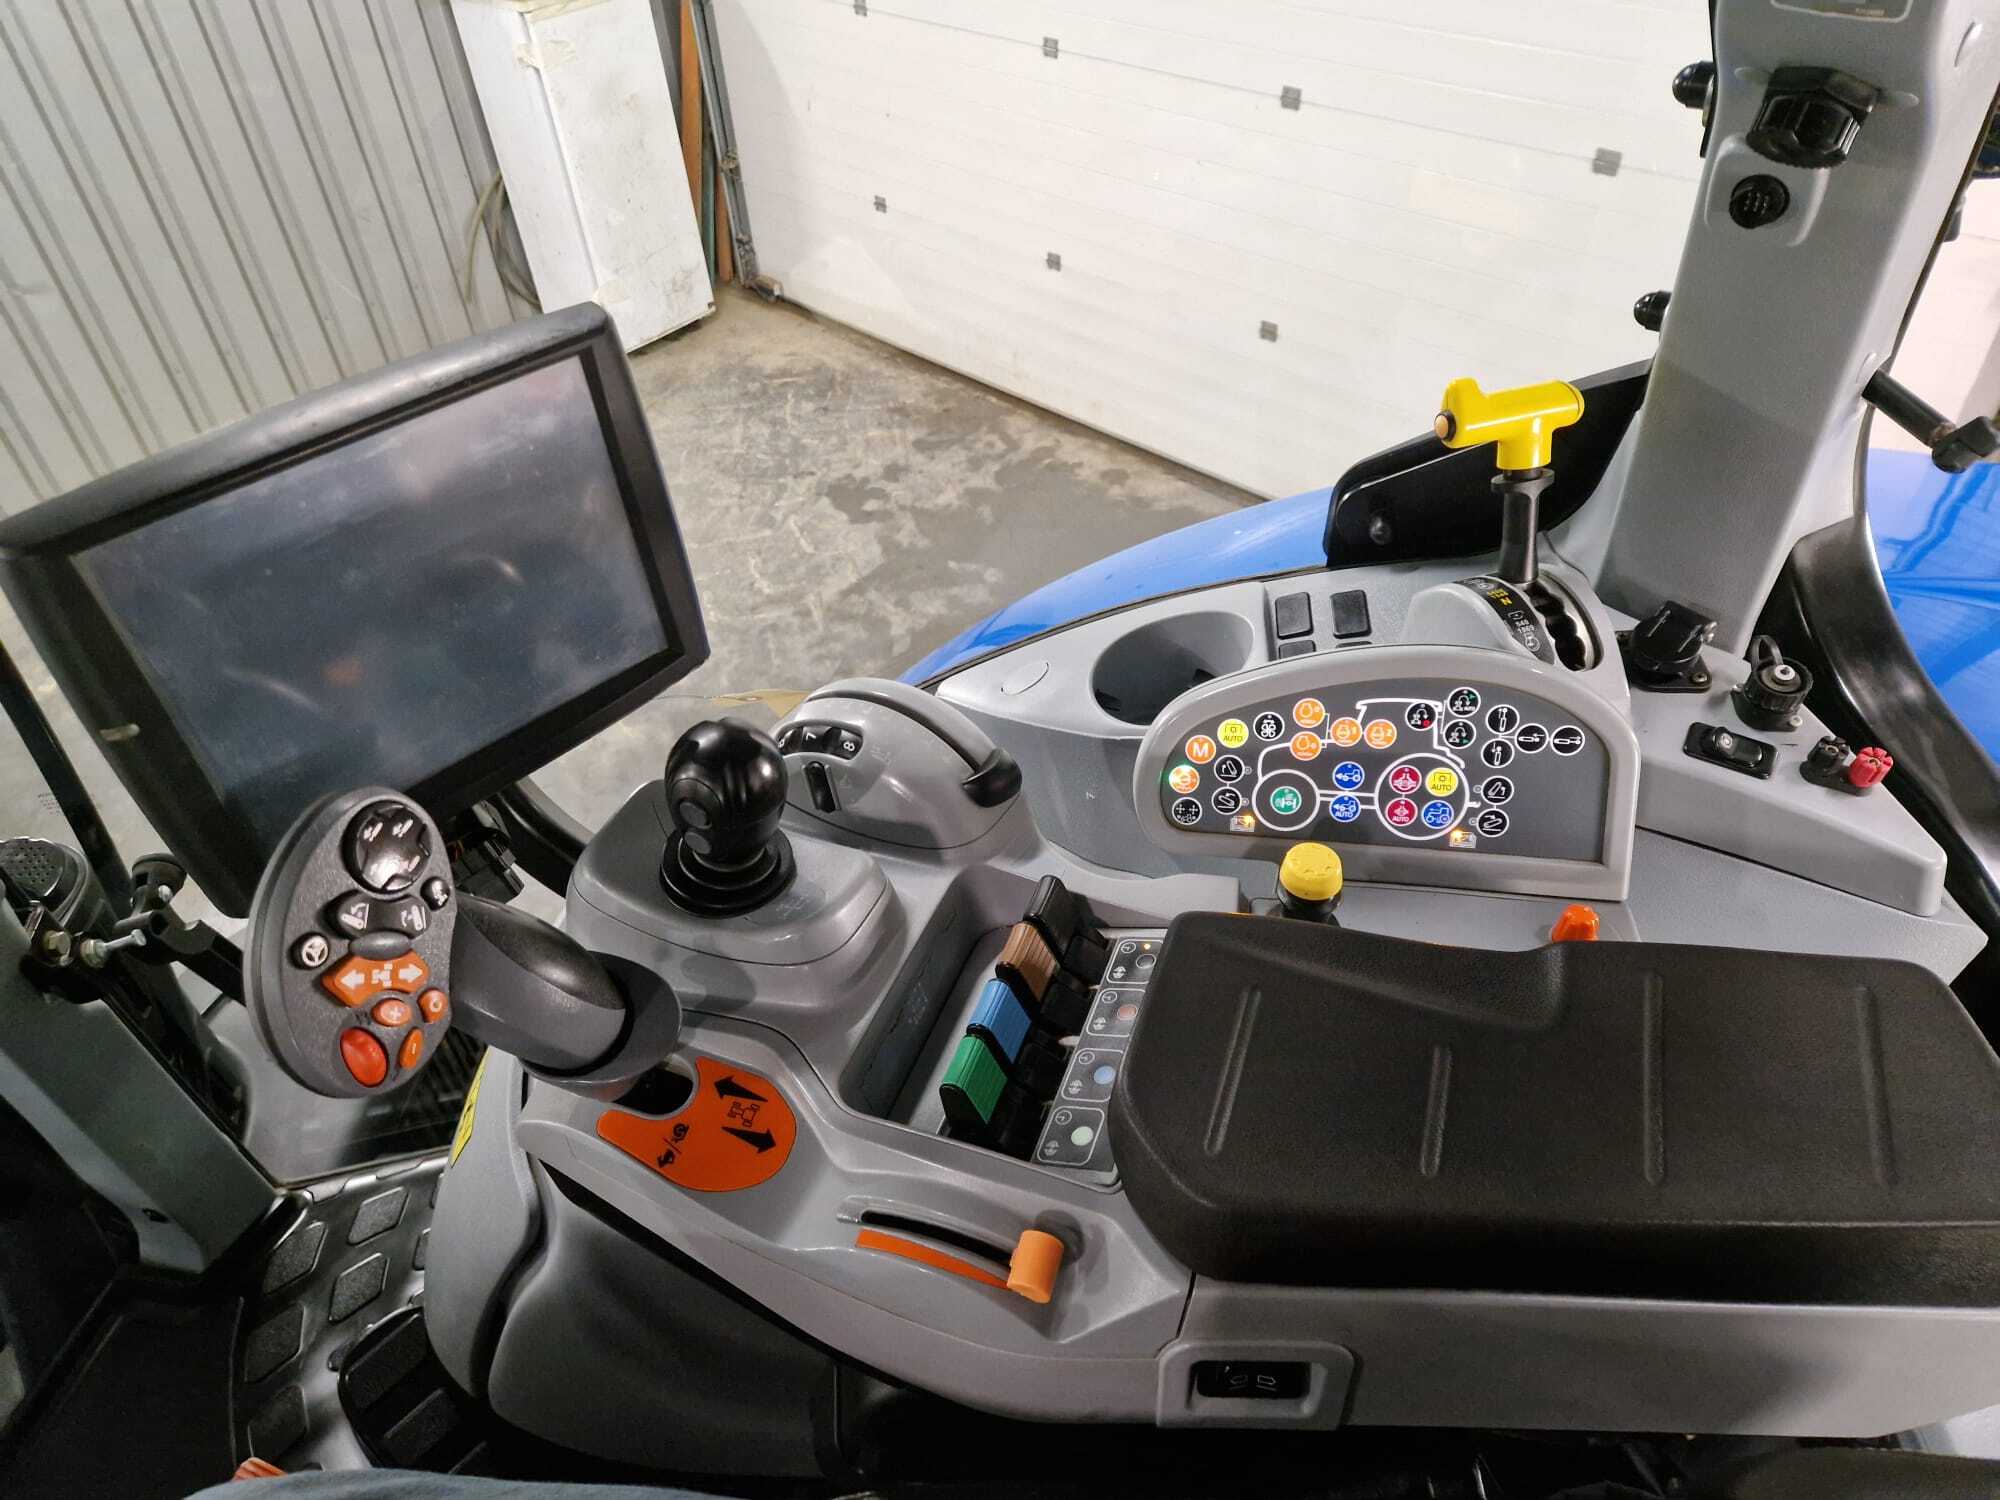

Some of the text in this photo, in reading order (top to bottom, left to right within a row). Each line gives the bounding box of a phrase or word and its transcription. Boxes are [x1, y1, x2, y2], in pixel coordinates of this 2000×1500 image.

[805, 732, 817, 741] 7
[843, 741, 856, 752] 8
[1192, 741, 1209, 757] M
[1431, 784, 1452, 792] AUTO
